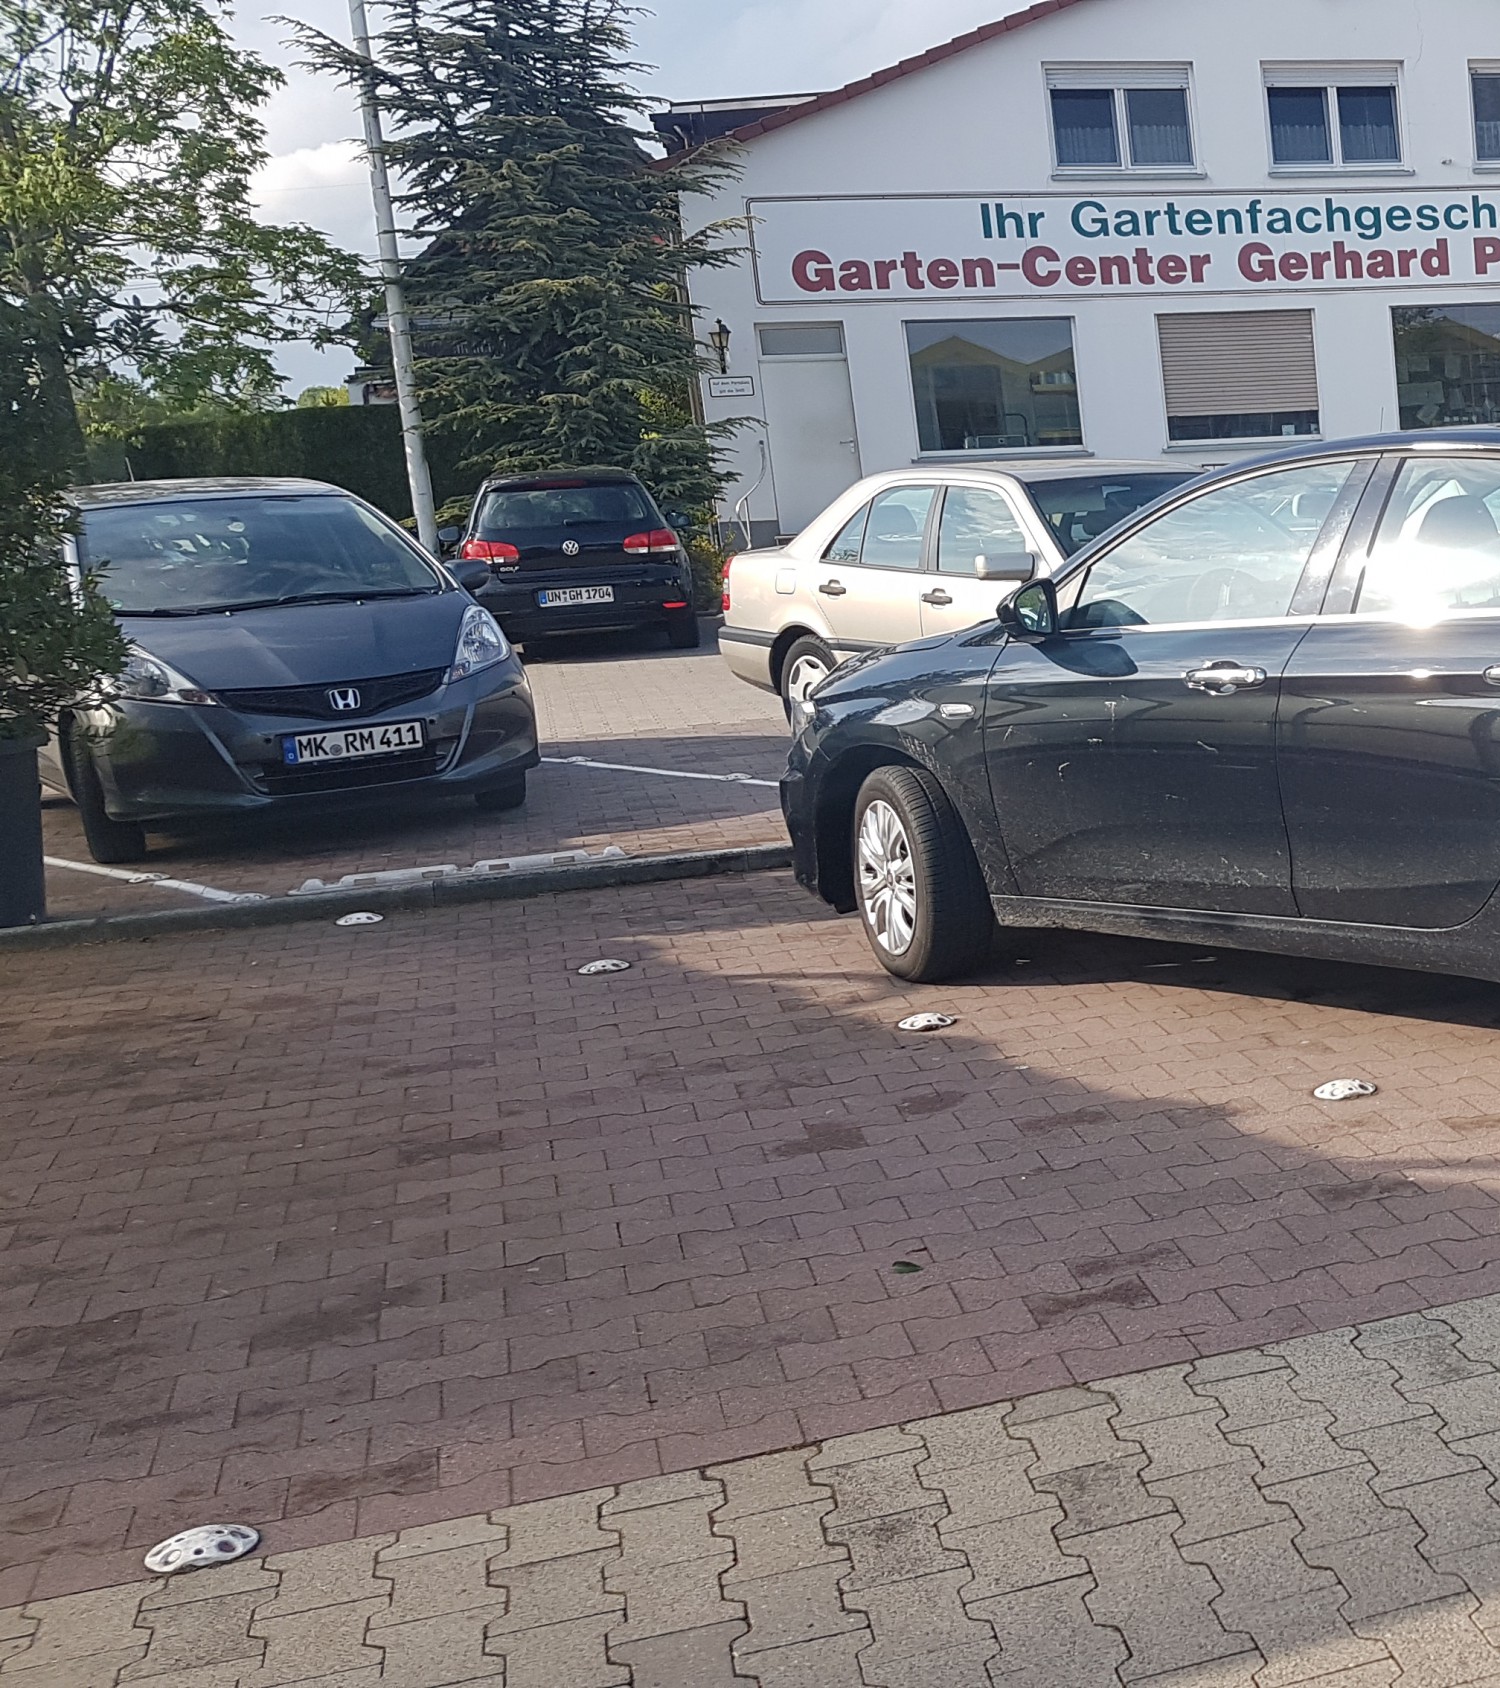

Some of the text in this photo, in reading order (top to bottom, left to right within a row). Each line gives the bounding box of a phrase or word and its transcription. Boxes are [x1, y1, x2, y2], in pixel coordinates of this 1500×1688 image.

[980, 202, 1046, 240] Ihr
[791, 245, 1212, 293] Garten-Center
[1237, 238, 1450, 284] Gerhard
[547, 587, 611, 602] UN GH 1704
[297, 735, 330, 759] MK
[344, 730, 375, 754] RM
[379, 724, 420, 749] 411
